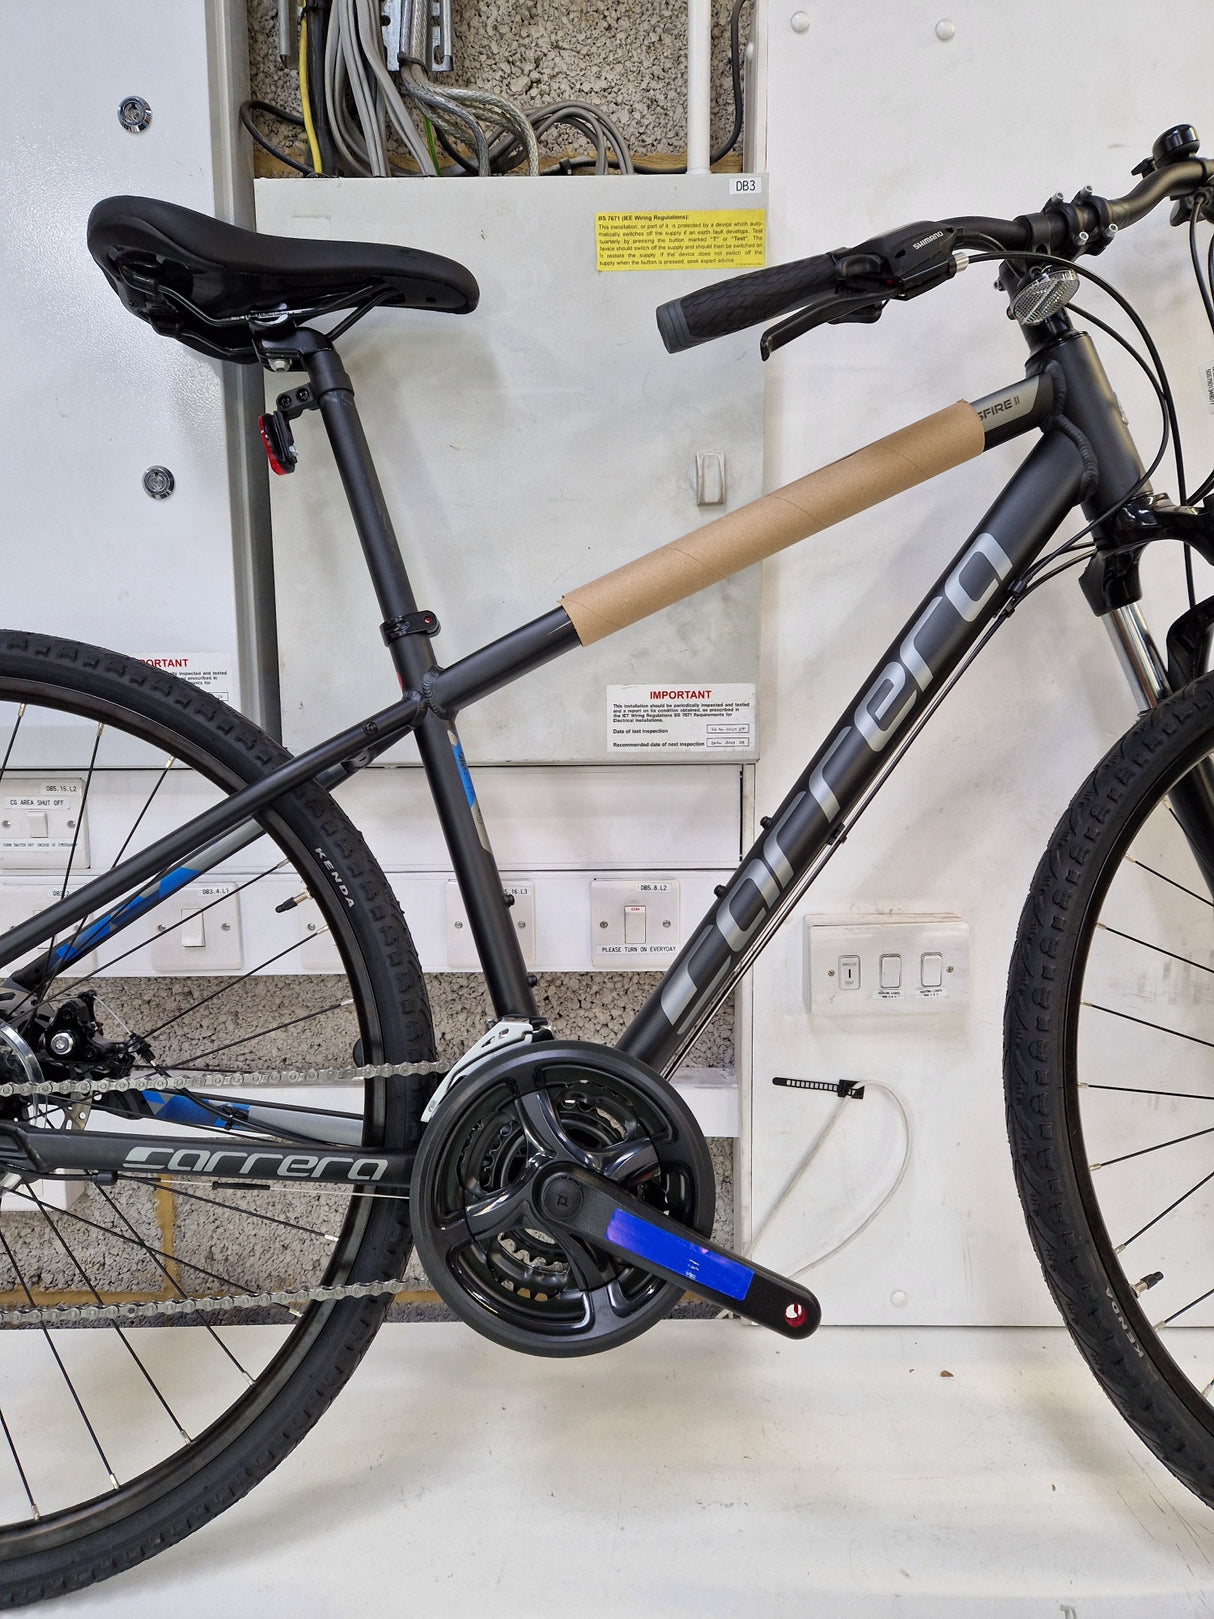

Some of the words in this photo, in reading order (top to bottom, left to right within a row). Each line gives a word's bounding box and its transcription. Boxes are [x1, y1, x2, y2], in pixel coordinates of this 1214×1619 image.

[736, 180, 756, 191] DB3
[912, 231, 944, 250] SHIMANO
[650, 690, 712, 699] IMPORTANT
[661, 532, 1013, 1035] carrera
[315, 848, 354, 908] KENDA
[123, 1146, 388, 1181] carrera
[1106, 1287, 1144, 1358] KENDA
